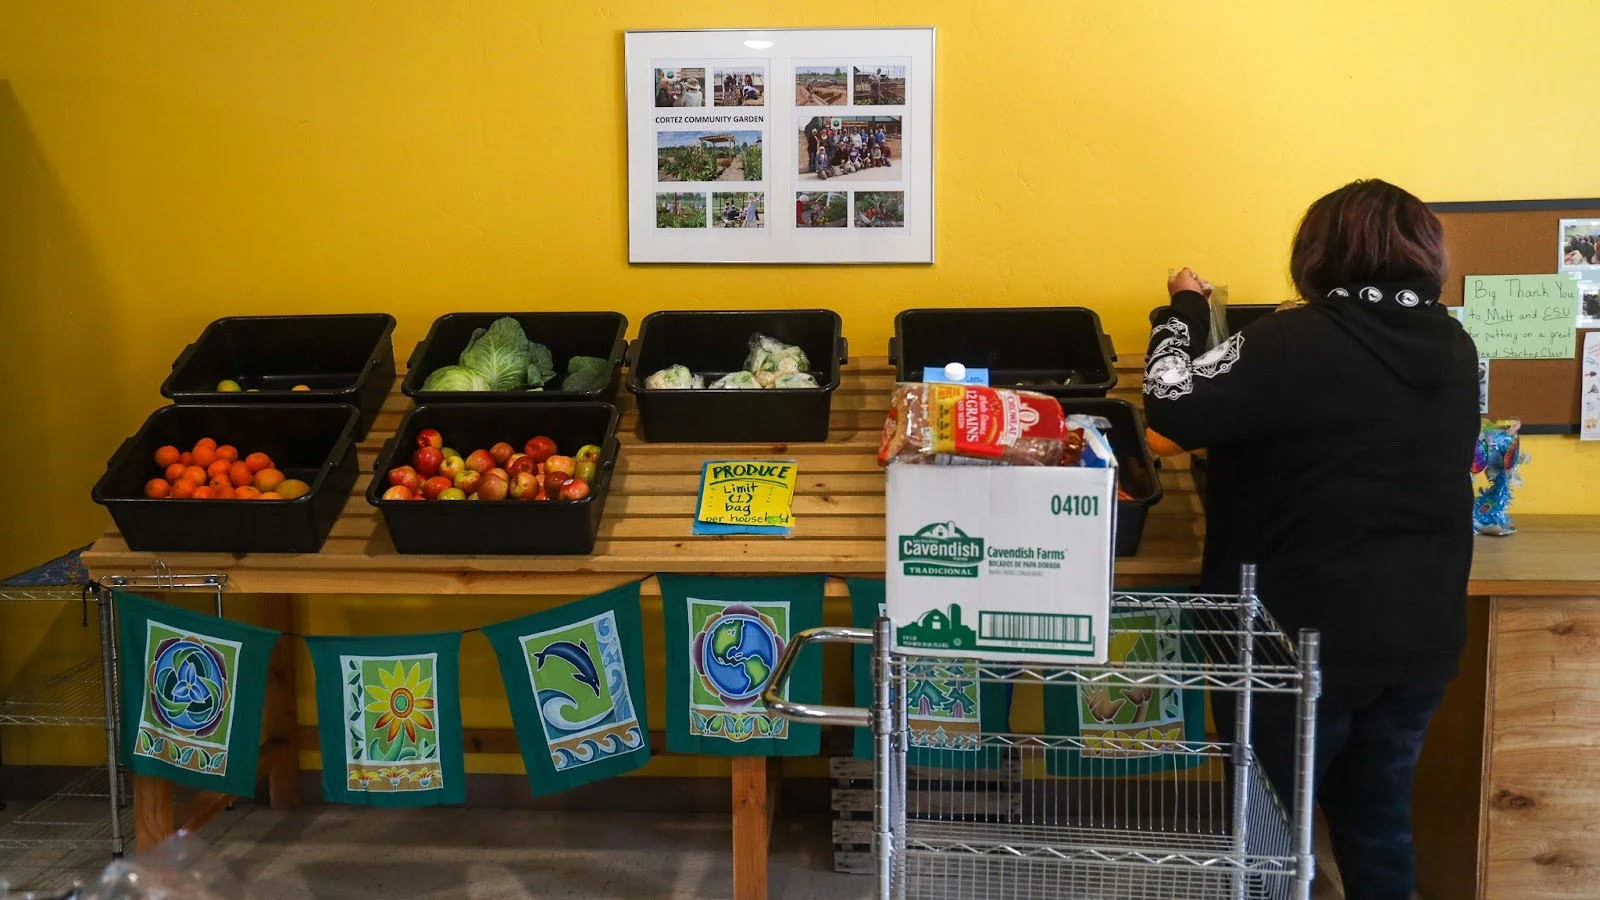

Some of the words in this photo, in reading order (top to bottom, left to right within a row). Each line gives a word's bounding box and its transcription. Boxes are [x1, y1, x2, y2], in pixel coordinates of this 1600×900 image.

[655, 116, 683, 124] CORTEZ
[733, 115, 764, 123] GARDEN
[1474, 279, 1496, 306] Big
[1503, 278, 1550, 299] Thank
[1555, 280, 1575, 299] You
[1469, 308, 1481, 320] to
[1486, 308, 1513, 321] Matt
[1519, 309, 1537, 319] and
[1544, 306, 1570, 318] CSU
[1484, 328, 1518, 344] putting
[1549, 327, 1571, 345] great
[1502, 347, 1538, 359] Starting
[712, 463, 791, 479] PRODUCE
[723, 482, 758, 494] Limit
[728, 493, 753, 504] (1)
[1050, 494, 1099, 516] 04101
[725, 502, 751, 517] bag
[903, 539, 980, 558] Cavendish
[987, 546, 1035, 559] Cavendish
[1036, 547, 1066, 561] Farms
[909, 566, 973, 576] TRADICIONAL
